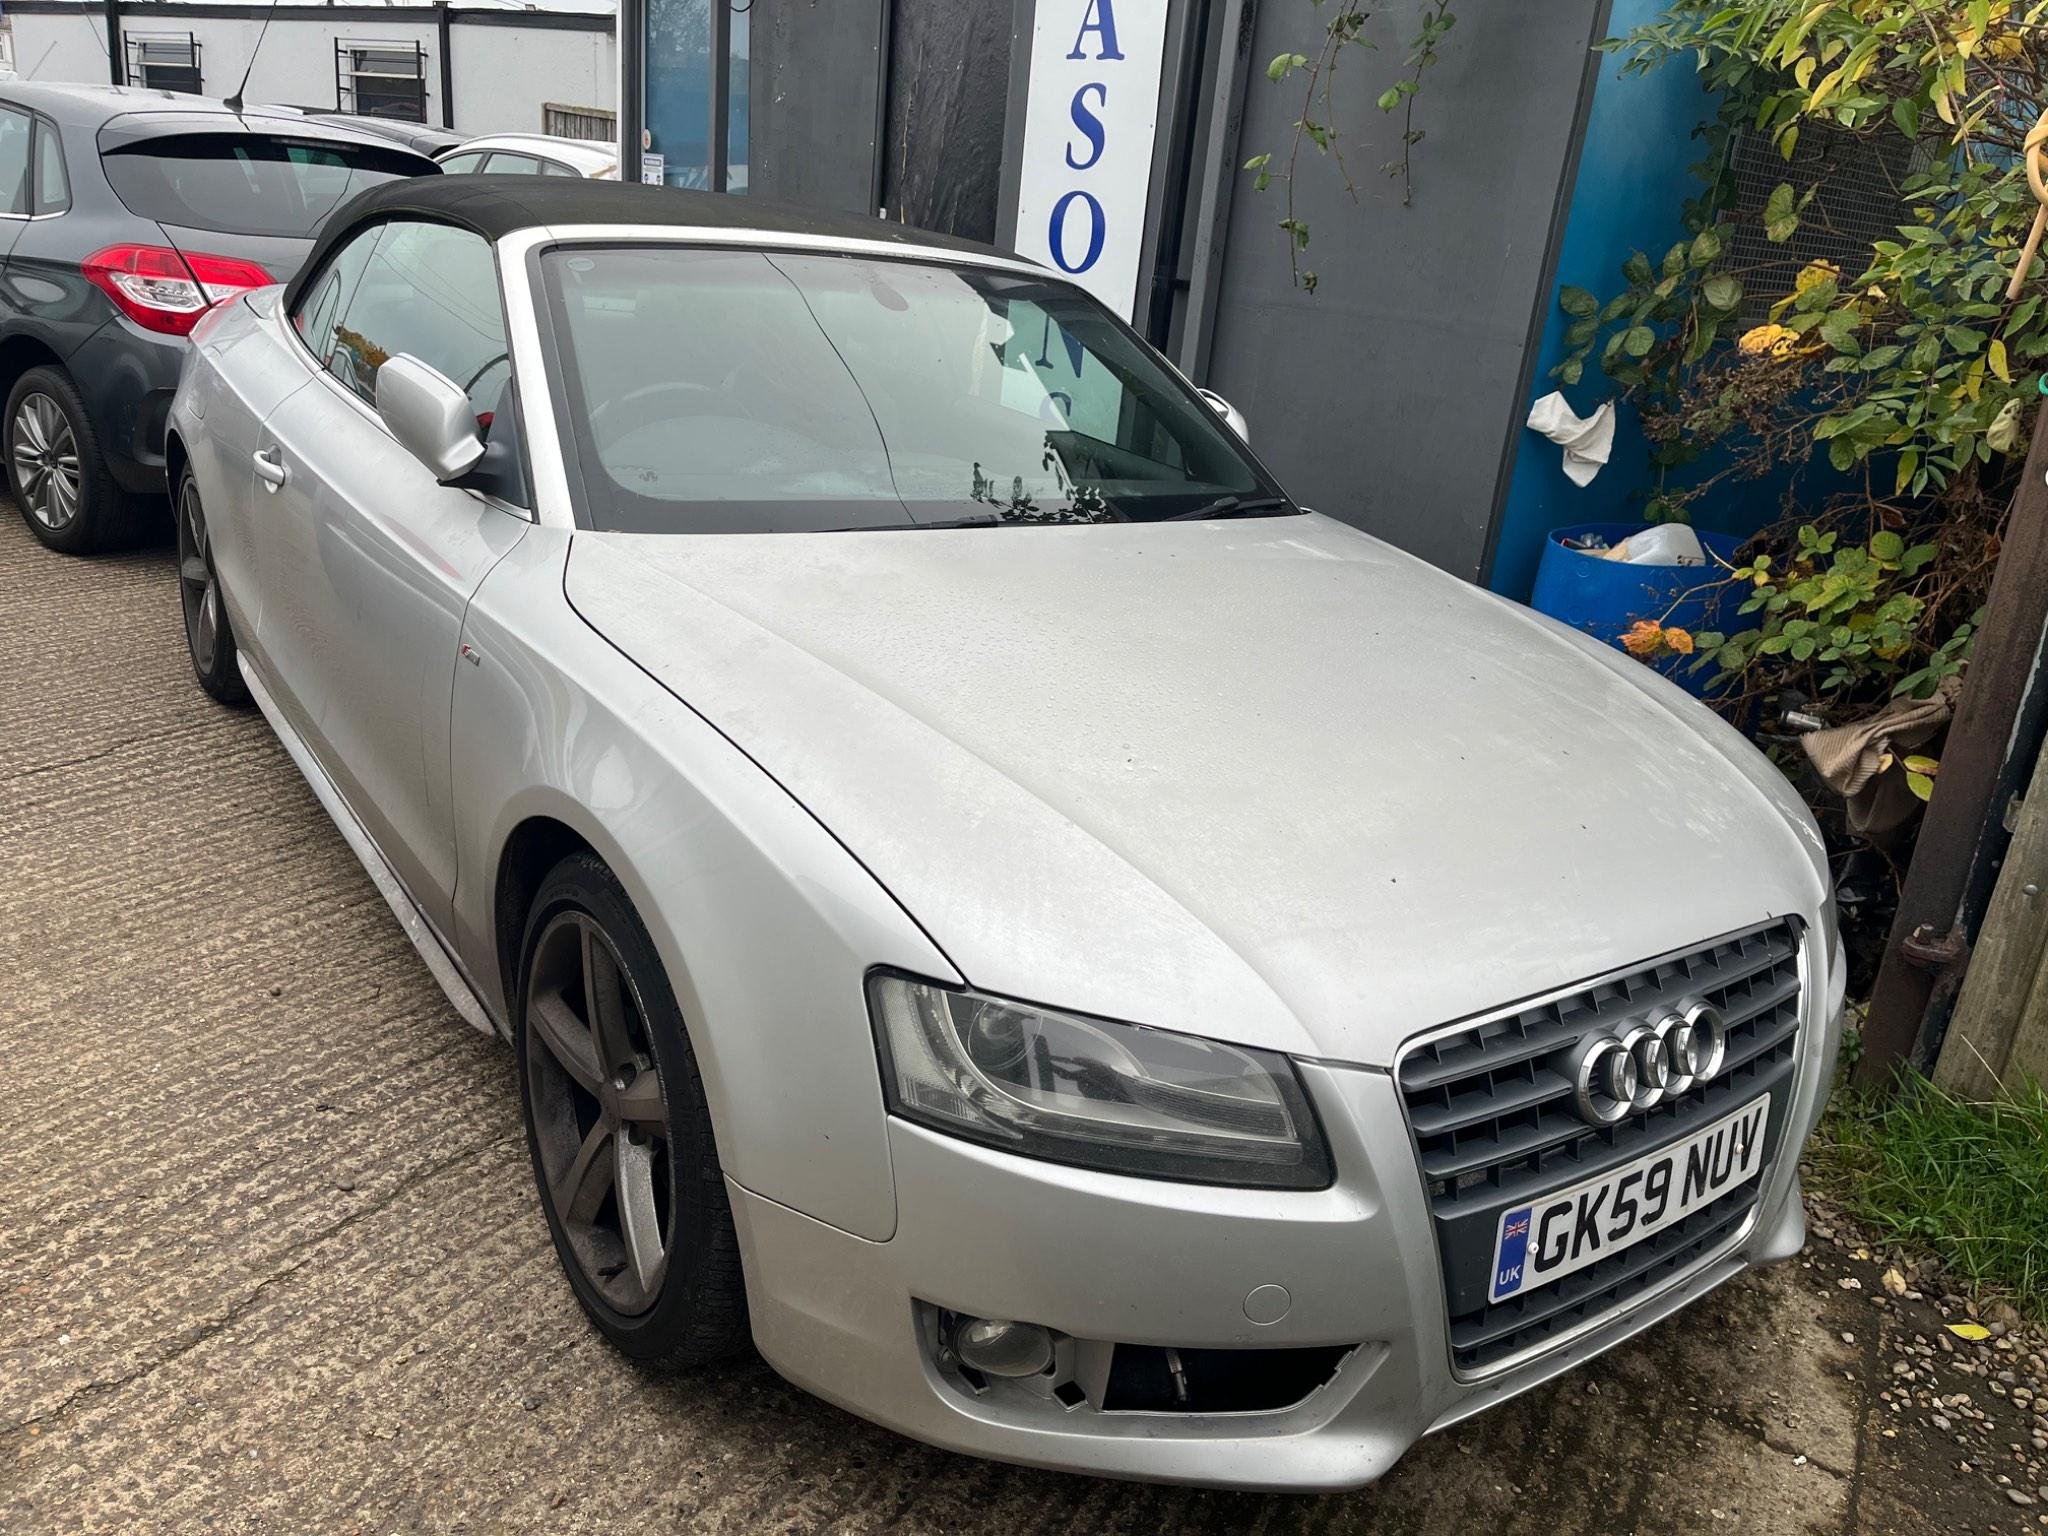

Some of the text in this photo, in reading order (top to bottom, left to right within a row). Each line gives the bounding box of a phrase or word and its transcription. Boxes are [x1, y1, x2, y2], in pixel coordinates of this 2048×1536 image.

[1533, 1107, 1763, 1274] GK59 NUV
[1499, 1264, 1521, 1285] UK
